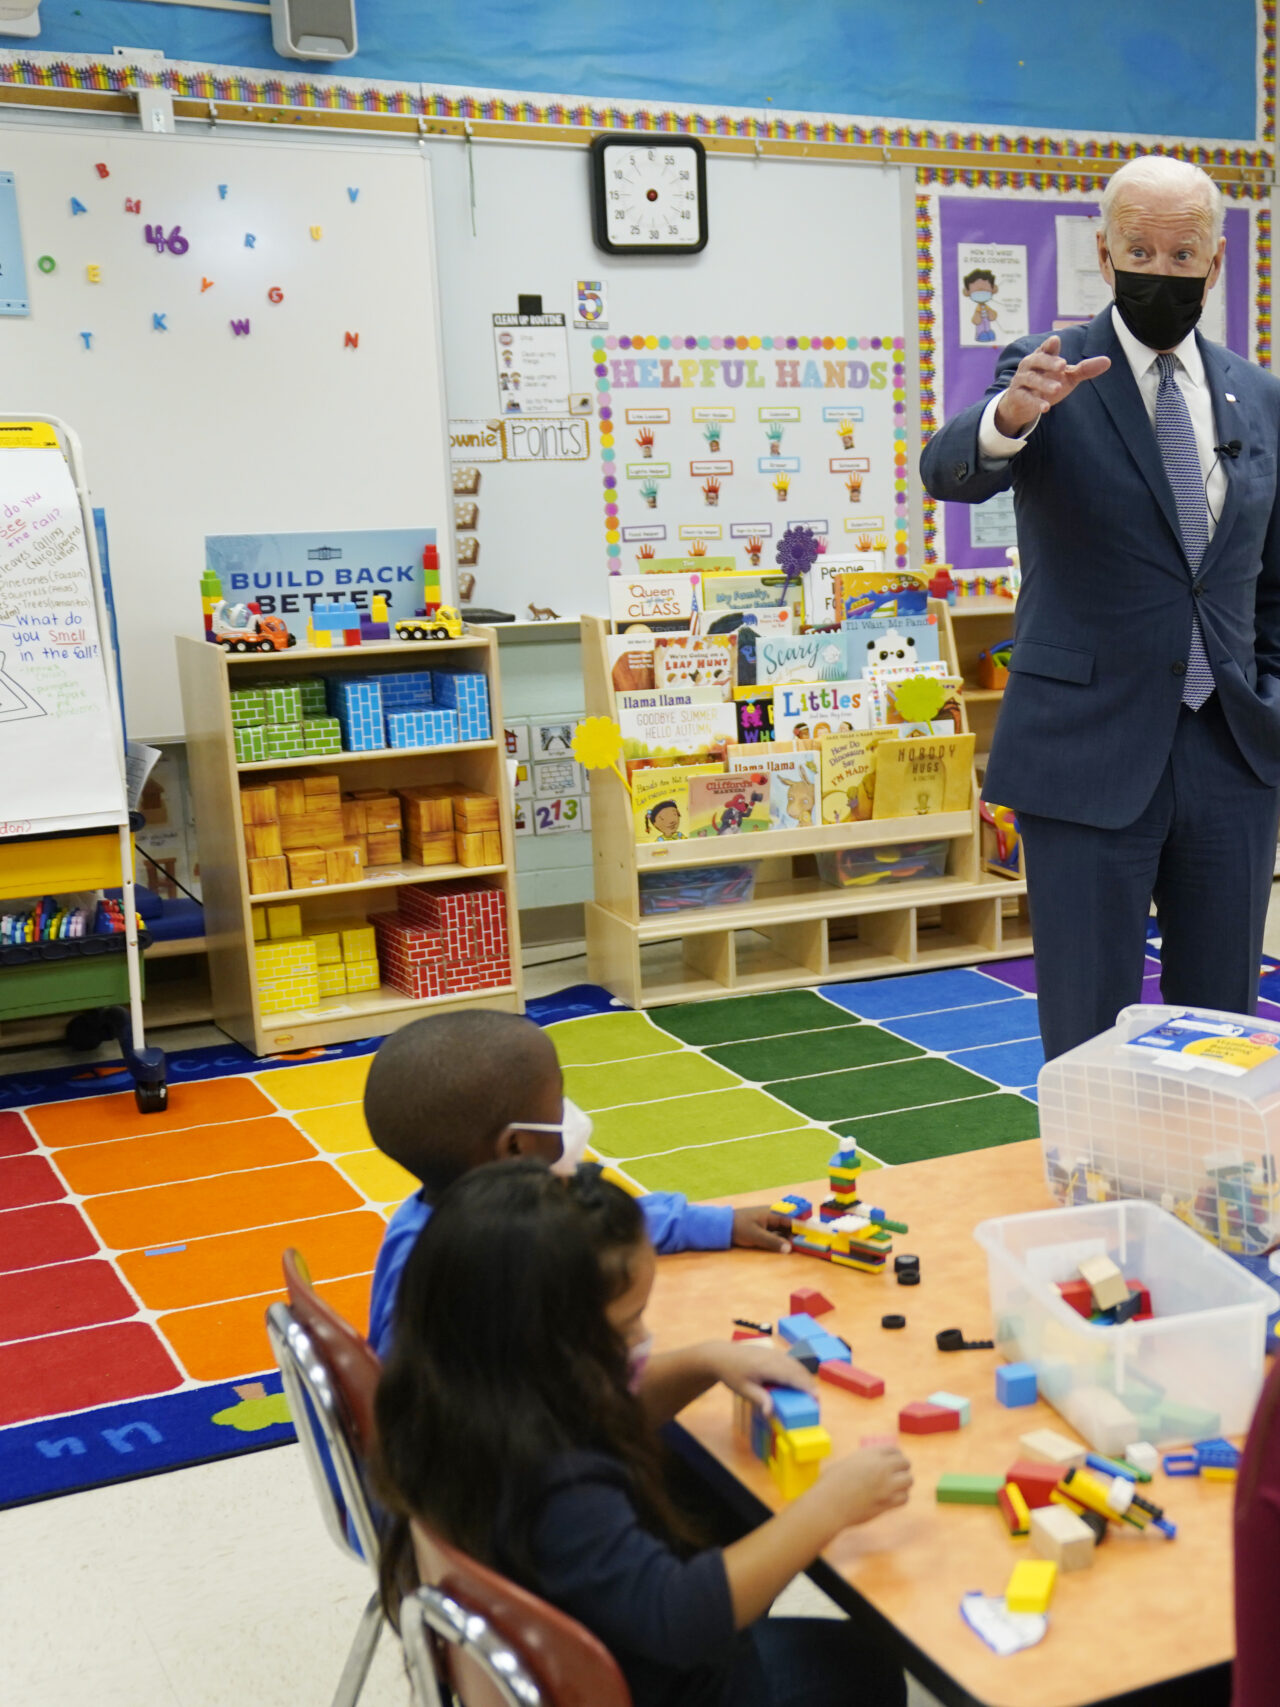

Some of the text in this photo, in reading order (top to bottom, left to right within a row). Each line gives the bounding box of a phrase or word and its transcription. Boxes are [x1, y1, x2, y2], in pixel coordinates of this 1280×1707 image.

[630, 155, 636, 165] 5
[664, 155, 675, 165] 55
[95, 162, 110, 179] B
[218, 184, 228, 200] F
[347, 187, 359, 203] V
[609, 190, 619, 200] 15
[685, 191, 695, 200] 45
[70, 196, 88, 216] A
[615, 209, 625, 219] 20
[681, 210, 691, 219] 40
[630, 225, 640, 235] 25
[649, 230, 659, 239] 30
[668, 225, 678, 235] 35
[144, 223, 190, 256] 46
[244, 233, 256, 249] R
[87, 264, 102, 283] E
[268, 286, 284, 304] G
[577, 281, 603, 321] 5
[152, 312, 168, 331] K
[80, 331, 93, 350] T
[609, 359, 888, 390] HELPFUL HANDS
[4, 492, 42, 518] do you
[230, 565, 415, 590] BUILD BACK
[629, 585, 675, 598] Queen
[254, 589, 393, 615] BETTER
[628, 602, 681, 617] CLASS
[17, 613, 58, 626] What
[65, 611, 82, 626] do
[905, 617, 929, 627] Pand
[13, 631, 40, 647] you
[21, 645, 98, 661] in the fall?
[763, 643, 822, 675] Scary
[697, 658, 728, 669] HUNT
[624, 695, 692, 709] llama llama
[783, 688, 862, 717] Littles
[637, 709, 718, 726] GOODBYE SUMMER
[646, 723, 712, 739] HELLO AUTUMN
[897, 744, 957, 762] NOBODY
[767, 760, 796, 771] llama
[912, 762, 940, 774] HUGS
[706, 778, 753, 791] Clifford's
